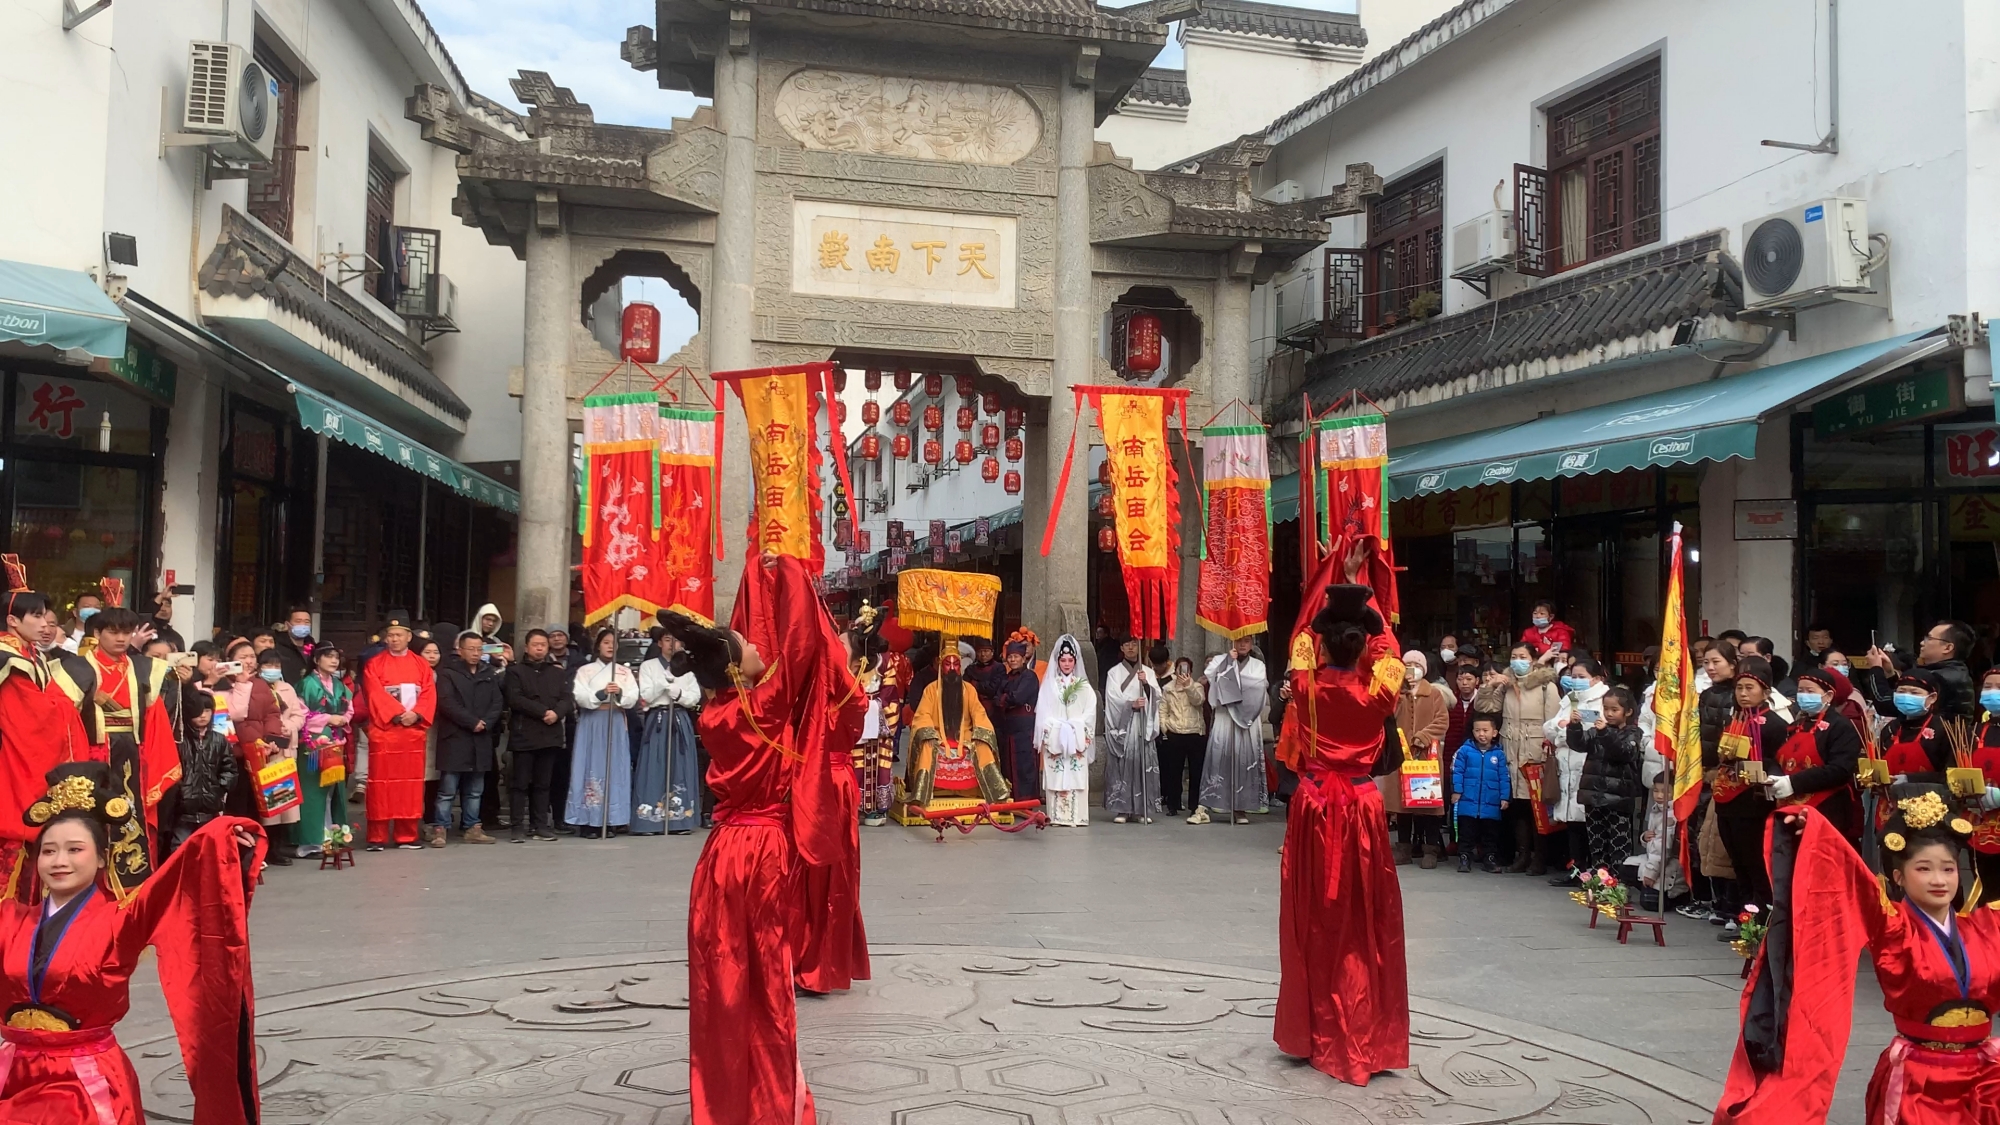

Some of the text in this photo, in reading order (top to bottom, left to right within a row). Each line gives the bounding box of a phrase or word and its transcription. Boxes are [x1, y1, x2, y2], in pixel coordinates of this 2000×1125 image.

[0, 314, 40, 330] tbon
[28, 381, 86, 438] 行
[1846, 380, 1917, 417] 御街
[1856, 405, 1908, 426] YU JIE
[1652, 440, 1690, 455] Cestbon
[1947, 428, 2000, 477] 旺
[765, 418, 791, 544] 南岳庙会
[1484, 465, 1514, 477] Cestbon
[1122, 434, 1152, 552] 南岳庙会
